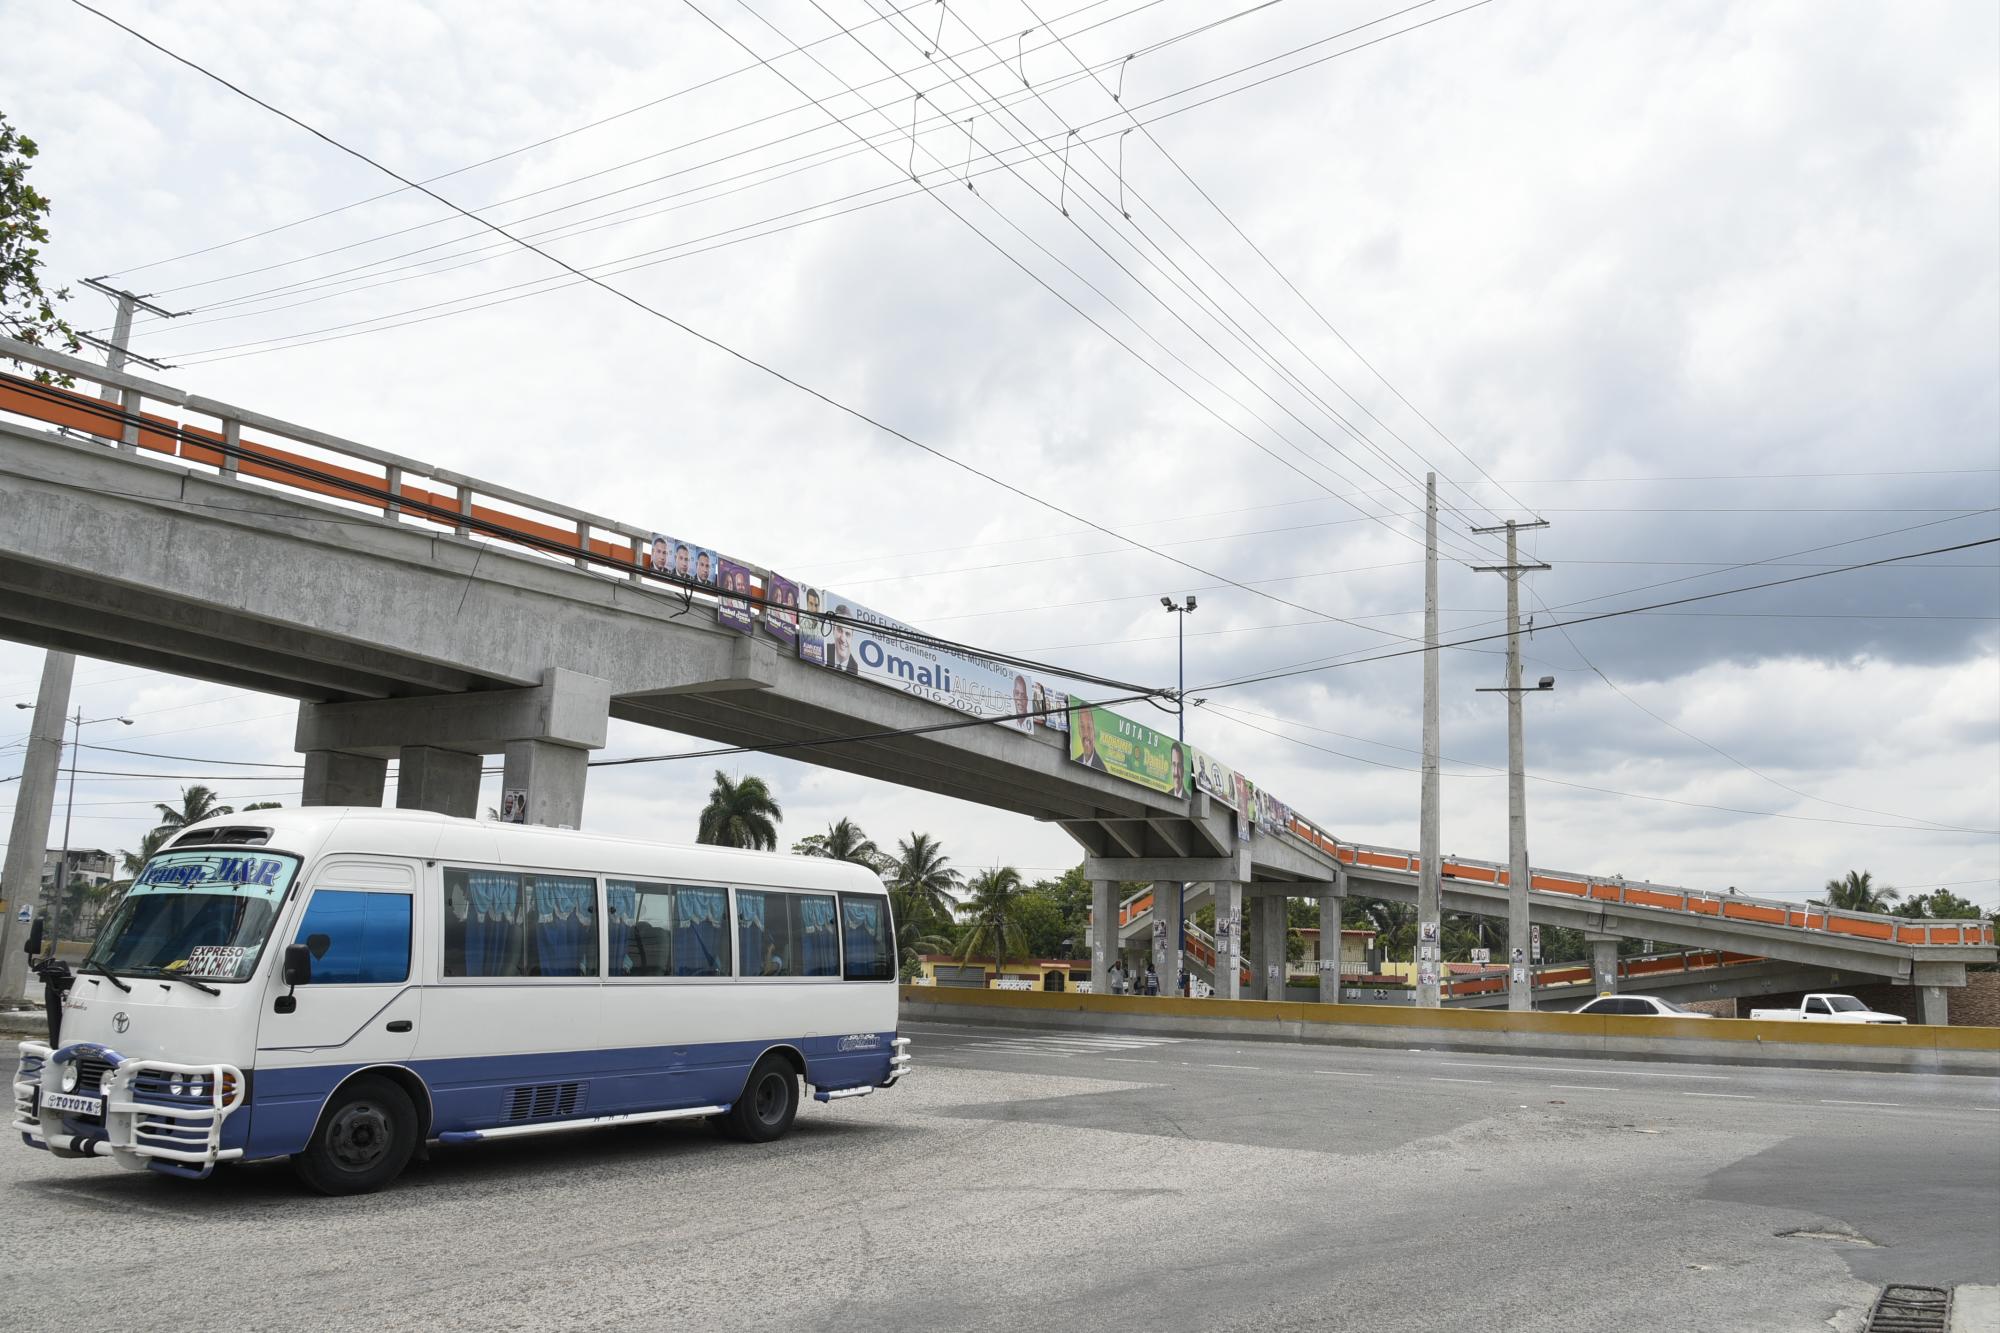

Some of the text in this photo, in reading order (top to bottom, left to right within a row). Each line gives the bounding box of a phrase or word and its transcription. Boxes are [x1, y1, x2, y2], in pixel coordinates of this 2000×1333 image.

[856, 608, 876, 625] POR
[967, 652, 1008, 678] MUNICIPIO
[872, 631, 937, 662] Rafael Caminero
[859, 640, 1012, 714] Omali ALCALDE
[904, 681, 983, 716] 2016-2020
[1119, 719, 1143, 741] VOTA
[1147, 732, 1159, 747] 19
[212, 857, 283, 886] M&R
[191, 946, 245, 957] EXPRESO
[207, 956, 239, 976] CHICA
[56, 1096, 94, 1112] TOYOTA
